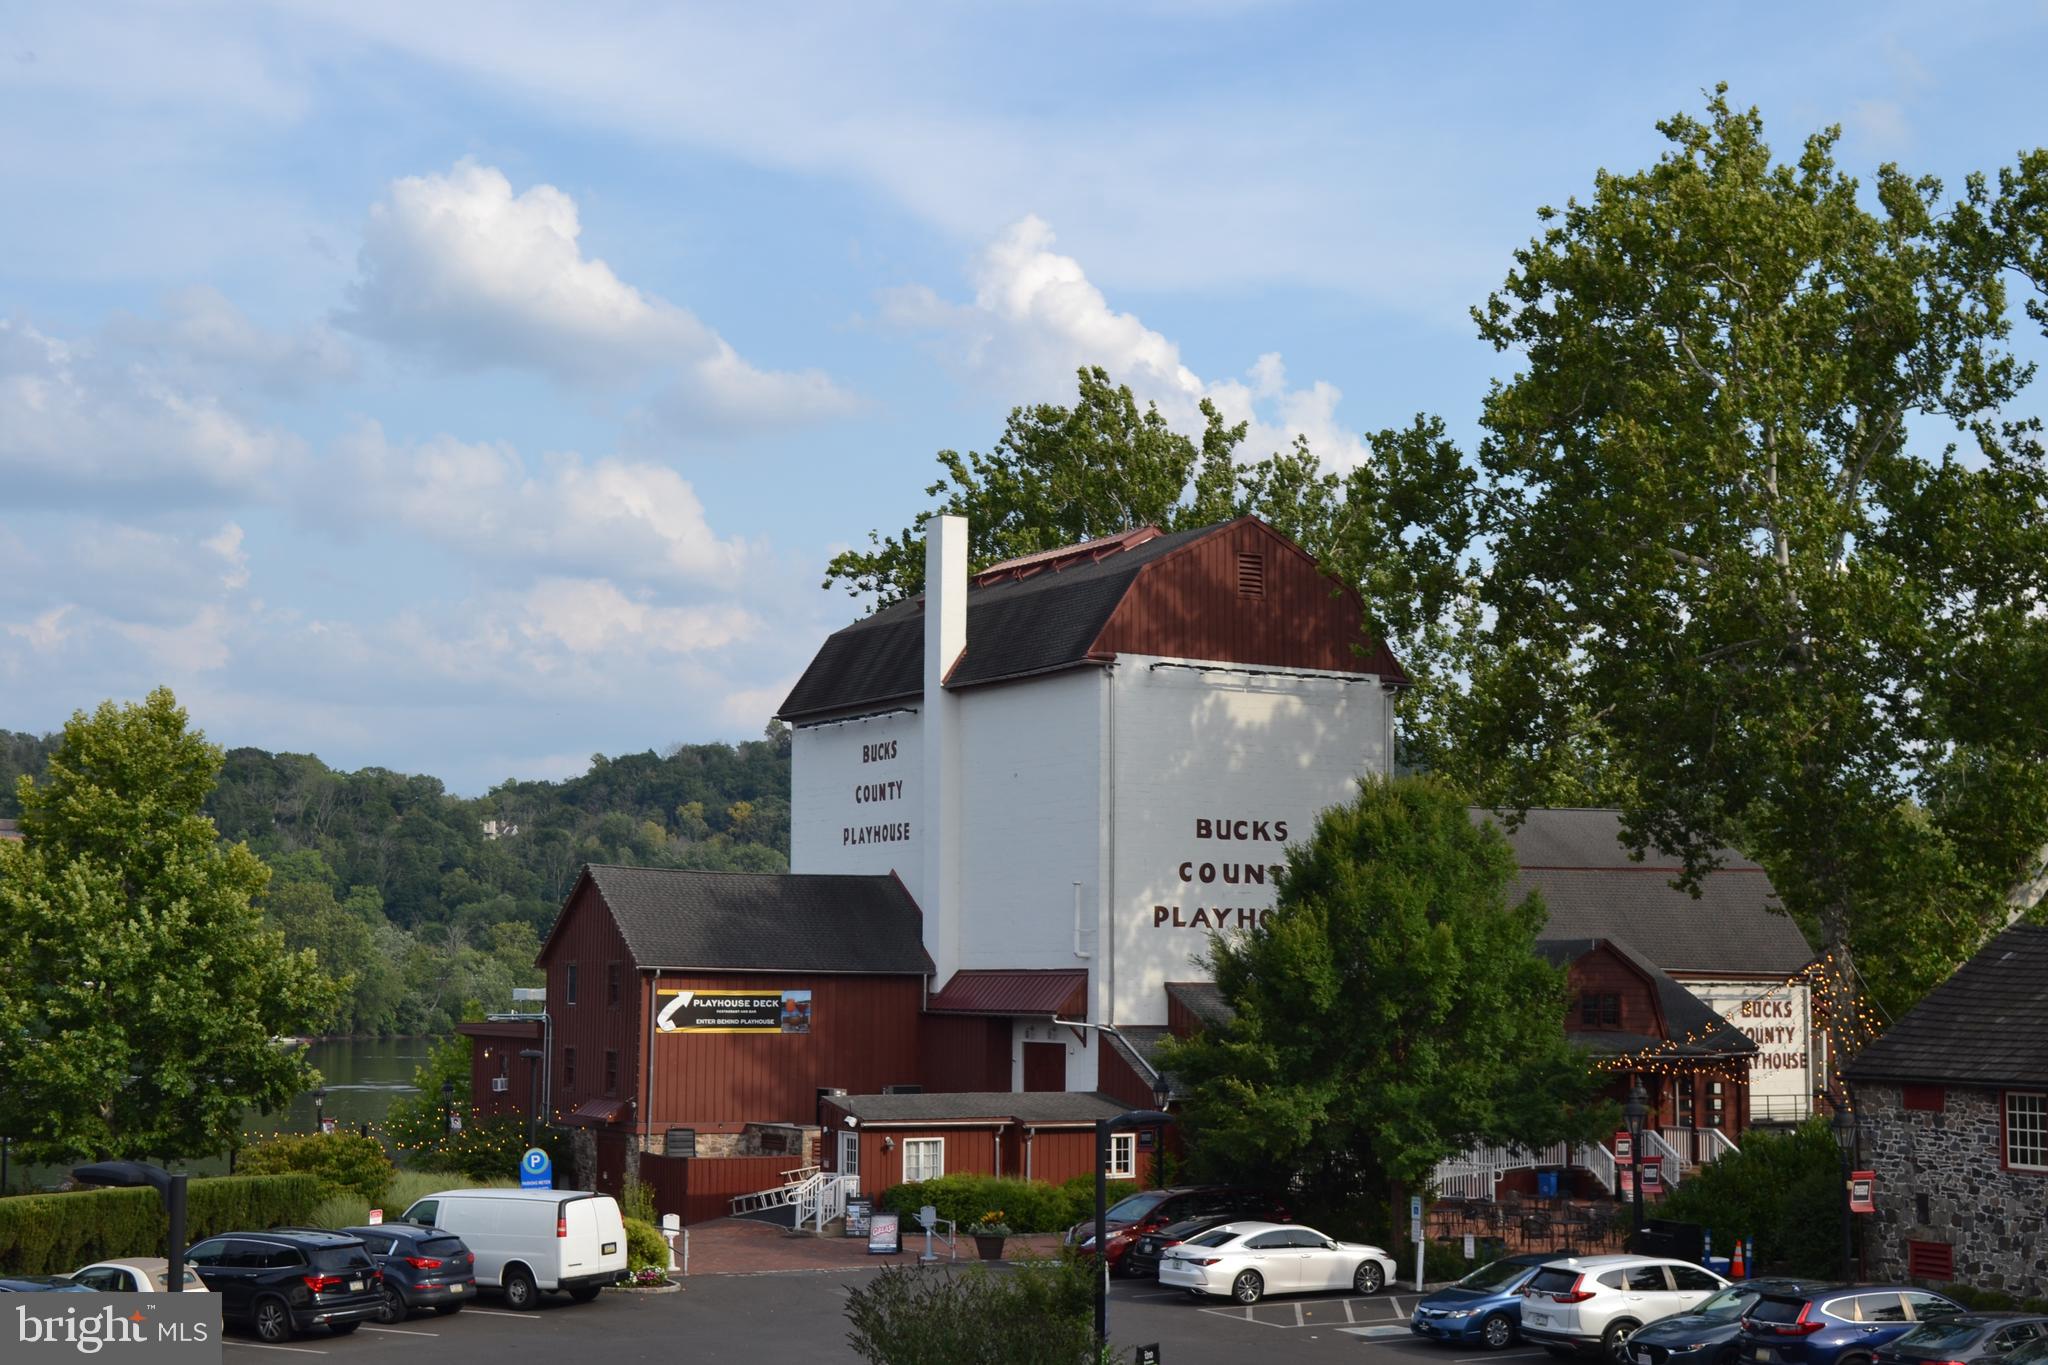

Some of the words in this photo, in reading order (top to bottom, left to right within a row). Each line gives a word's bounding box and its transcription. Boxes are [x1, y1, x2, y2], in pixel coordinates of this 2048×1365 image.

[863, 740, 897, 763] BUCKS
[855, 780, 903, 804] COUNTY
[843, 822, 910, 846] PLAYHOUSE
[1196, 818, 1288, 841] BUCKS
[1179, 862, 1285, 885] COUNT
[1153, 906, 1274, 929] PLAYHO
[693, 999, 751, 1007] PLAYHOUSE
[753, 999, 780, 1008] DECK
[1742, 1000, 1792, 1018] BUCKS
[531, 1155, 541, 1168] P
